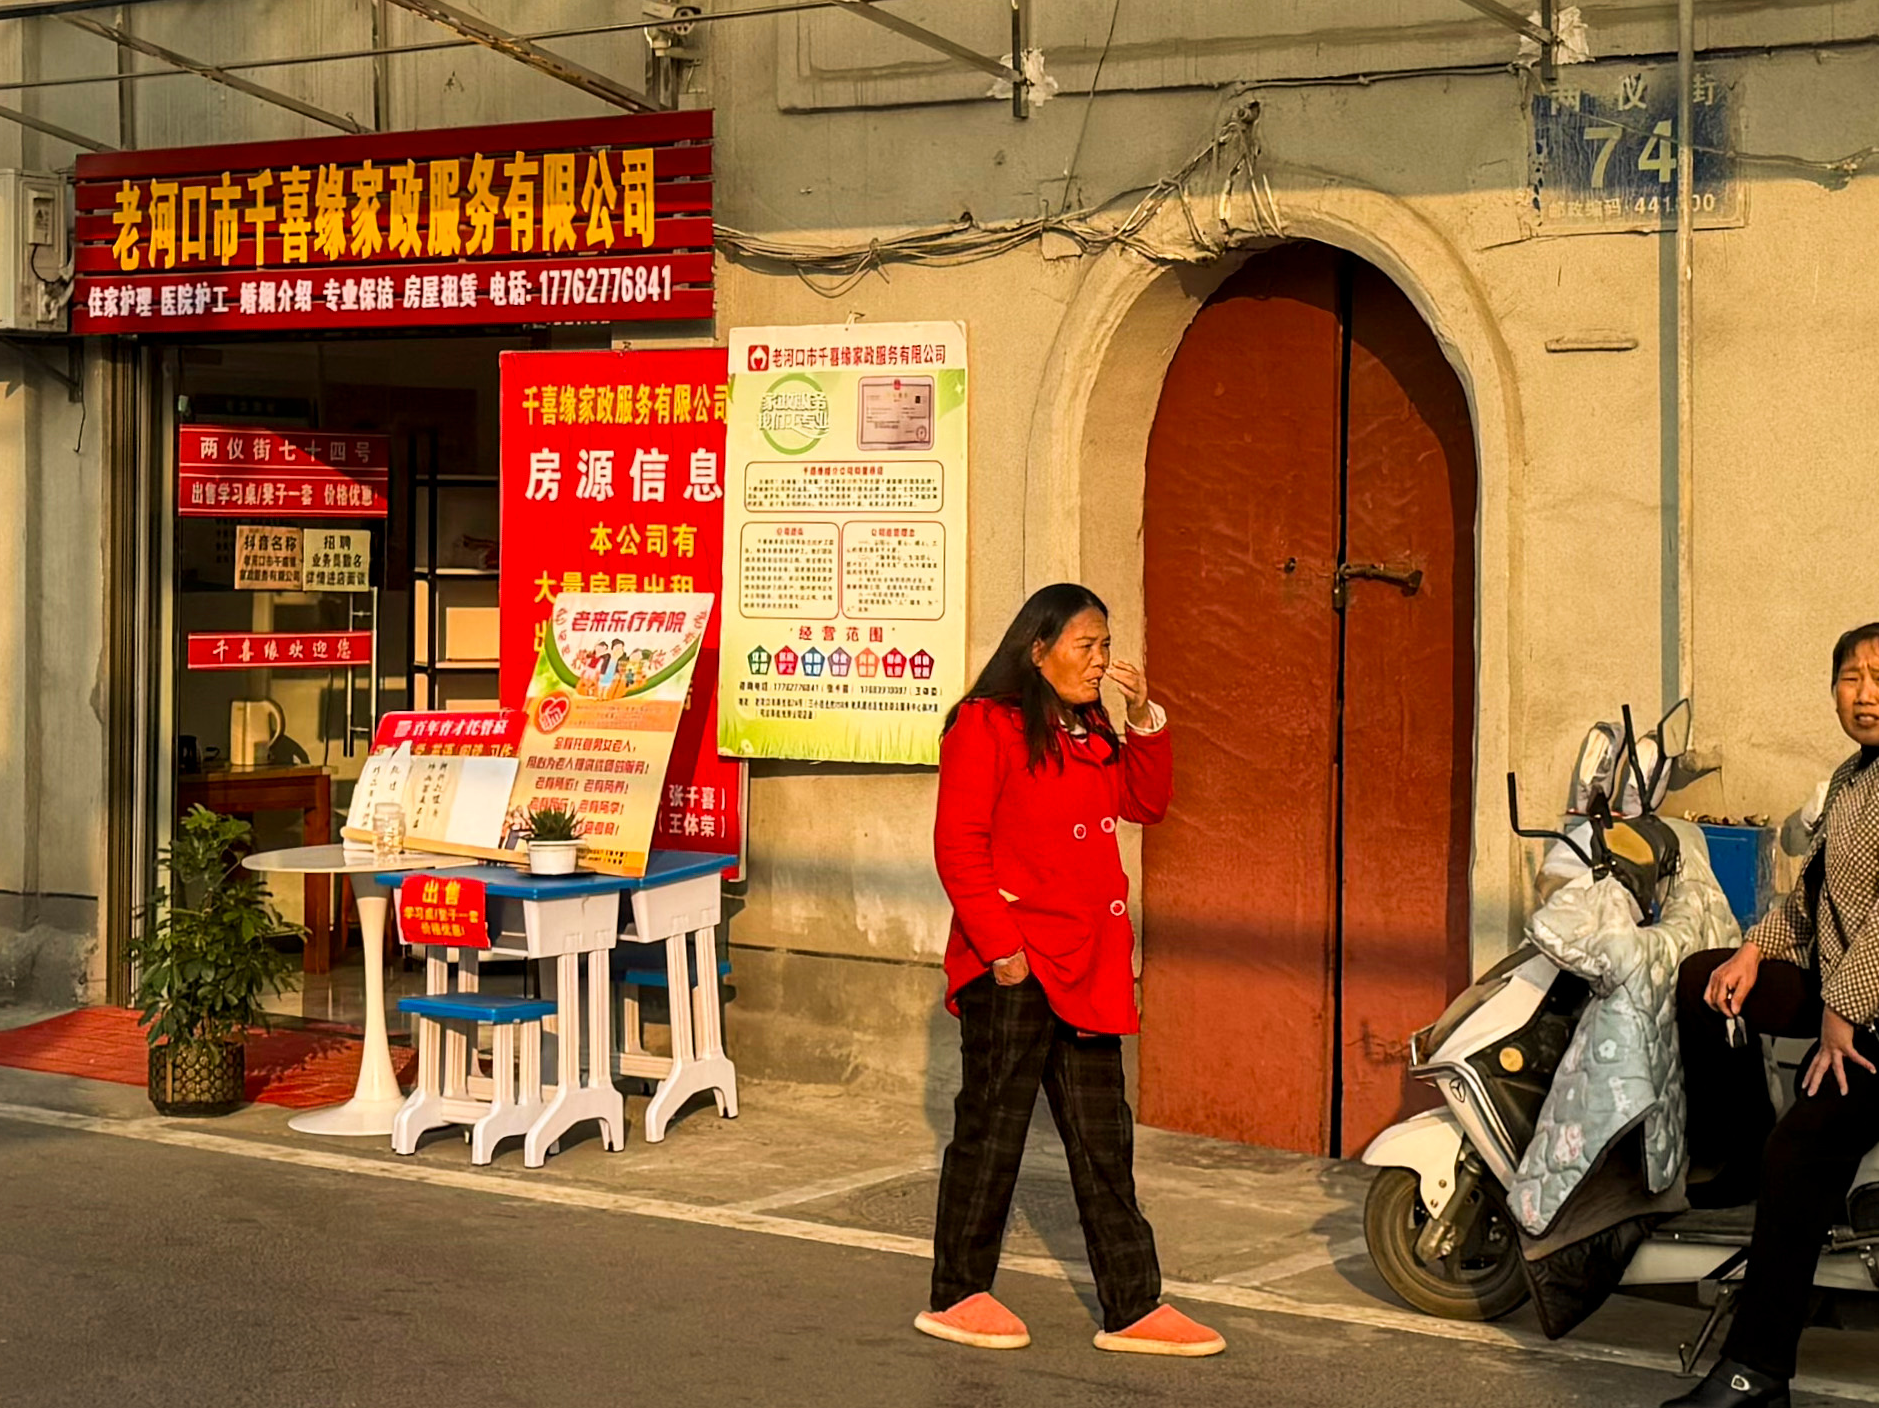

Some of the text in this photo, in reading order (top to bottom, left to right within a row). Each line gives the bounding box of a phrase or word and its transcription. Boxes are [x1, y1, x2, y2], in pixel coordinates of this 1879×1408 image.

[1583, 119, 1677, 190] 74
[112, 147, 656, 272] 老河口市千喜缘家政服务有限公司
[88, 284, 153, 318] 住家护理
[161, 282, 229, 316] 医院护工
[240, 279, 312, 314] 婚姻介绍
[323, 276, 394, 311] 专业保洁
[403, 273, 478, 309] 房屋租赁
[539, 264, 672, 306] 17762776841
[772, 344, 946, 368] 老河口市千喜缘家政服务有限公司
[522, 384, 728, 425] 千喜缘家政服务有限公司
[200, 436, 371, 463] 两仪街七十四号
[525, 448, 723, 502] 房源信息
[244, 535, 297, 551] 抖音名称
[324, 535, 351, 550] 招聘
[590, 521, 697, 558] 本公司有
[572, 610, 687, 633] 老来乐疗养院
[213, 638, 352, 662] 千喜缘欢迎您
